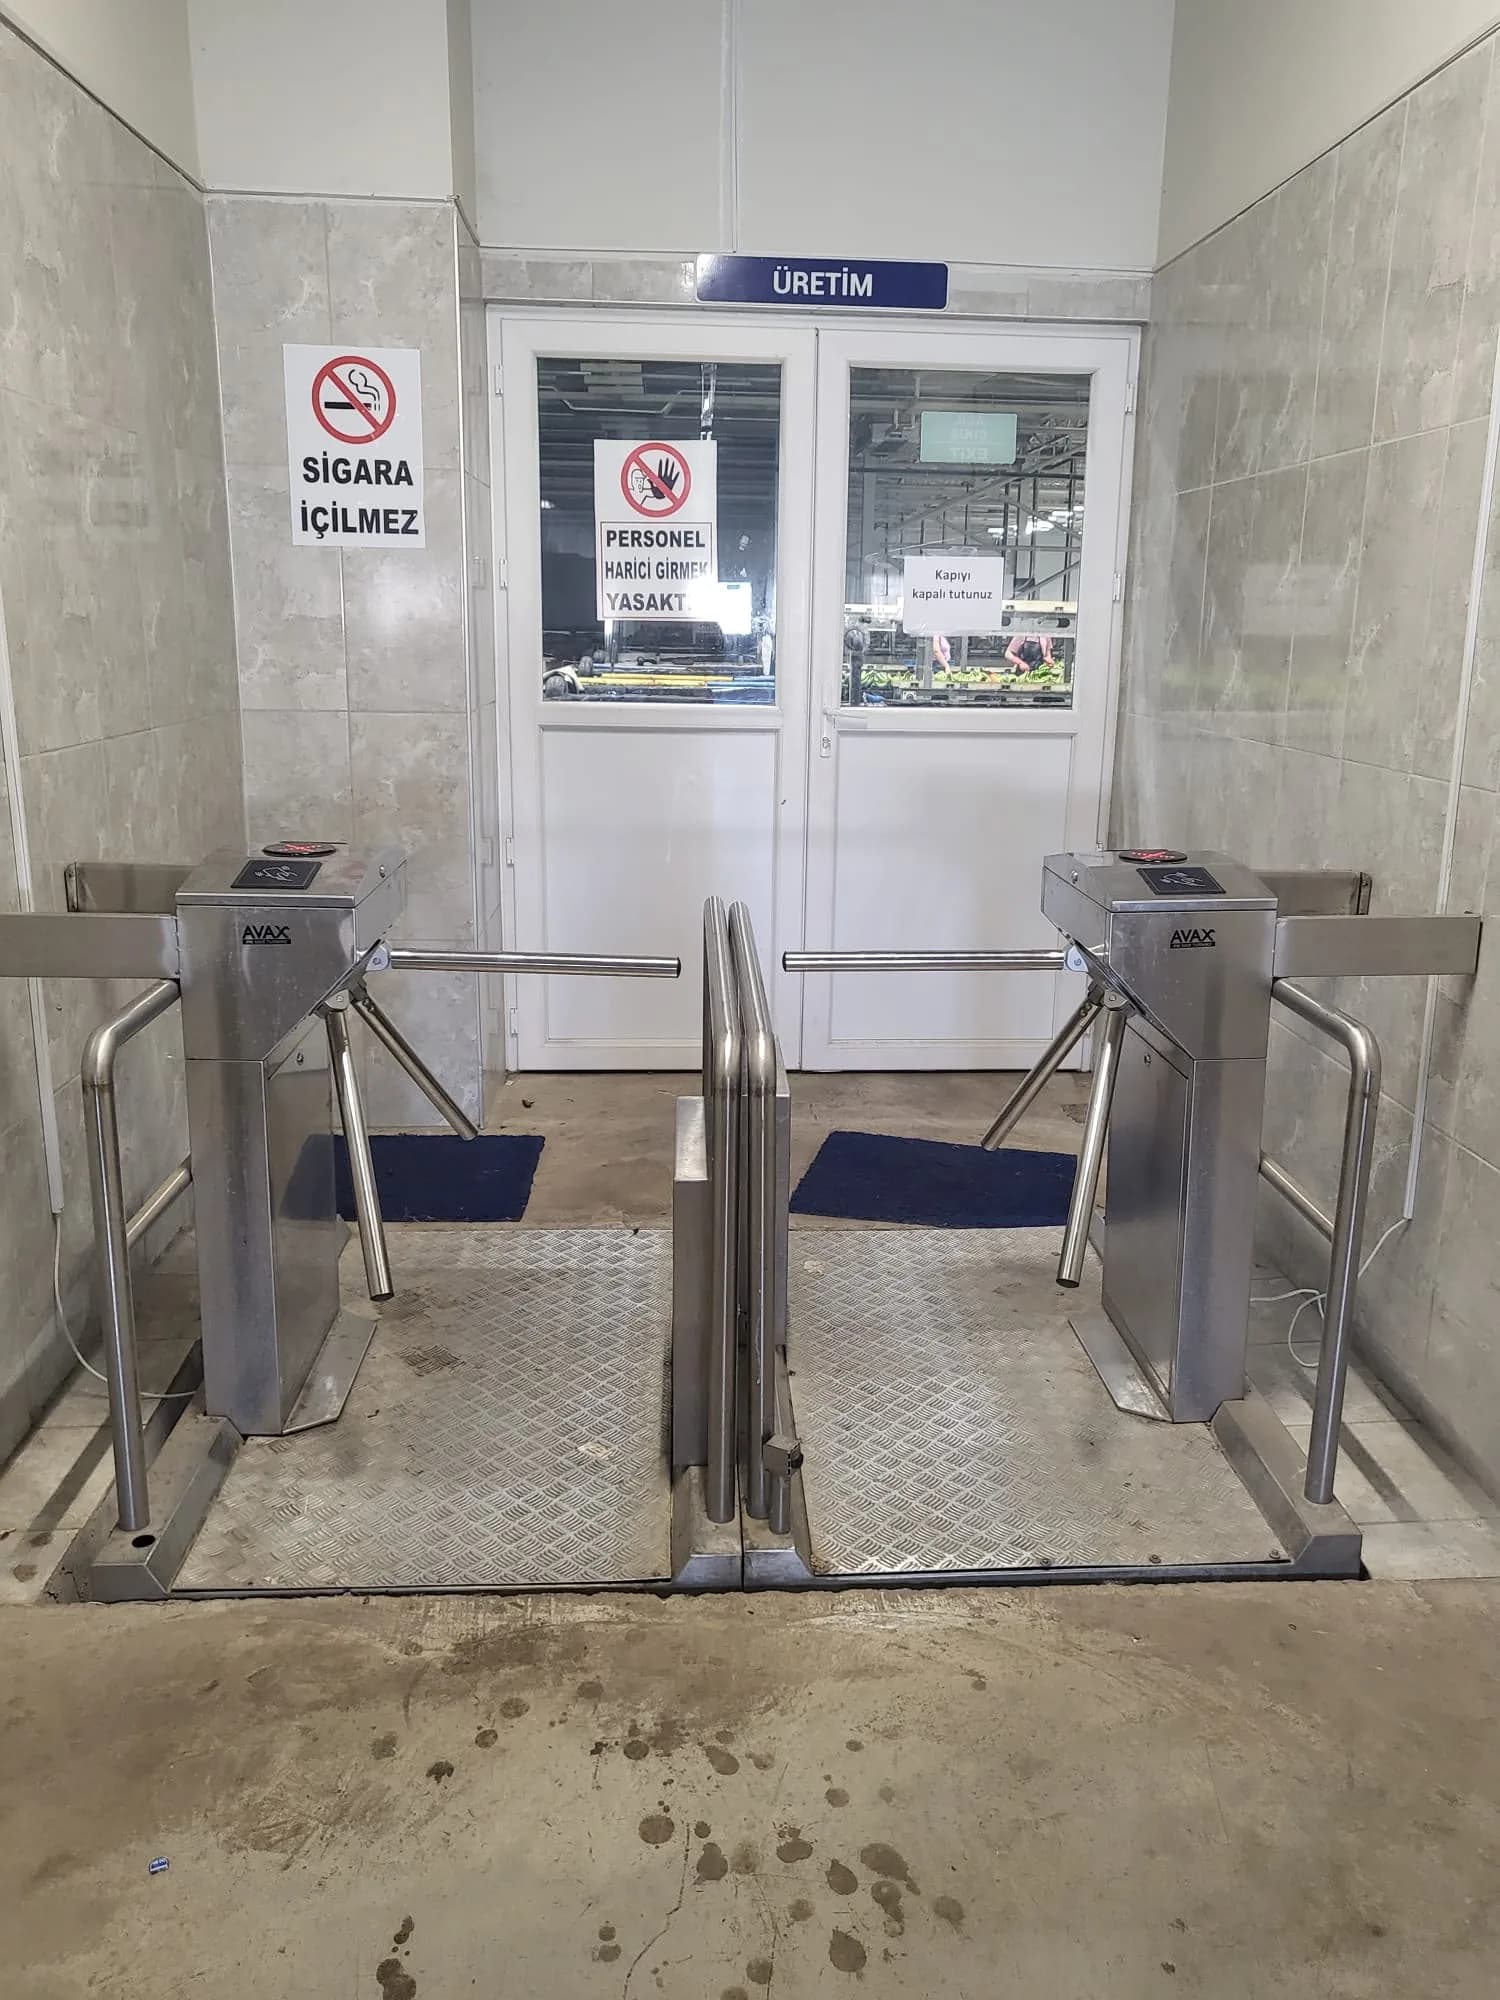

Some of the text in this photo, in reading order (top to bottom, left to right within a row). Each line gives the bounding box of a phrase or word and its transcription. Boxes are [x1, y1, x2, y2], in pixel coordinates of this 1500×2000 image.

[773, 265, 873, 297] ÜRETİM
[302, 450, 414, 486] SİGARA
[300, 499, 419, 539] İÇİLMEZ
[606, 530, 706, 548] PERSONEL
[605, 556, 708, 580] HARİCİ GİRMEK
[935, 569, 971, 583] Kapıyı
[606, 592, 693, 612] YASAKT
[912, 588, 993, 601] kapalı tutunuz
[242, 925, 290, 939] AVAX
[1170, 928, 1216, 943] AVAX
